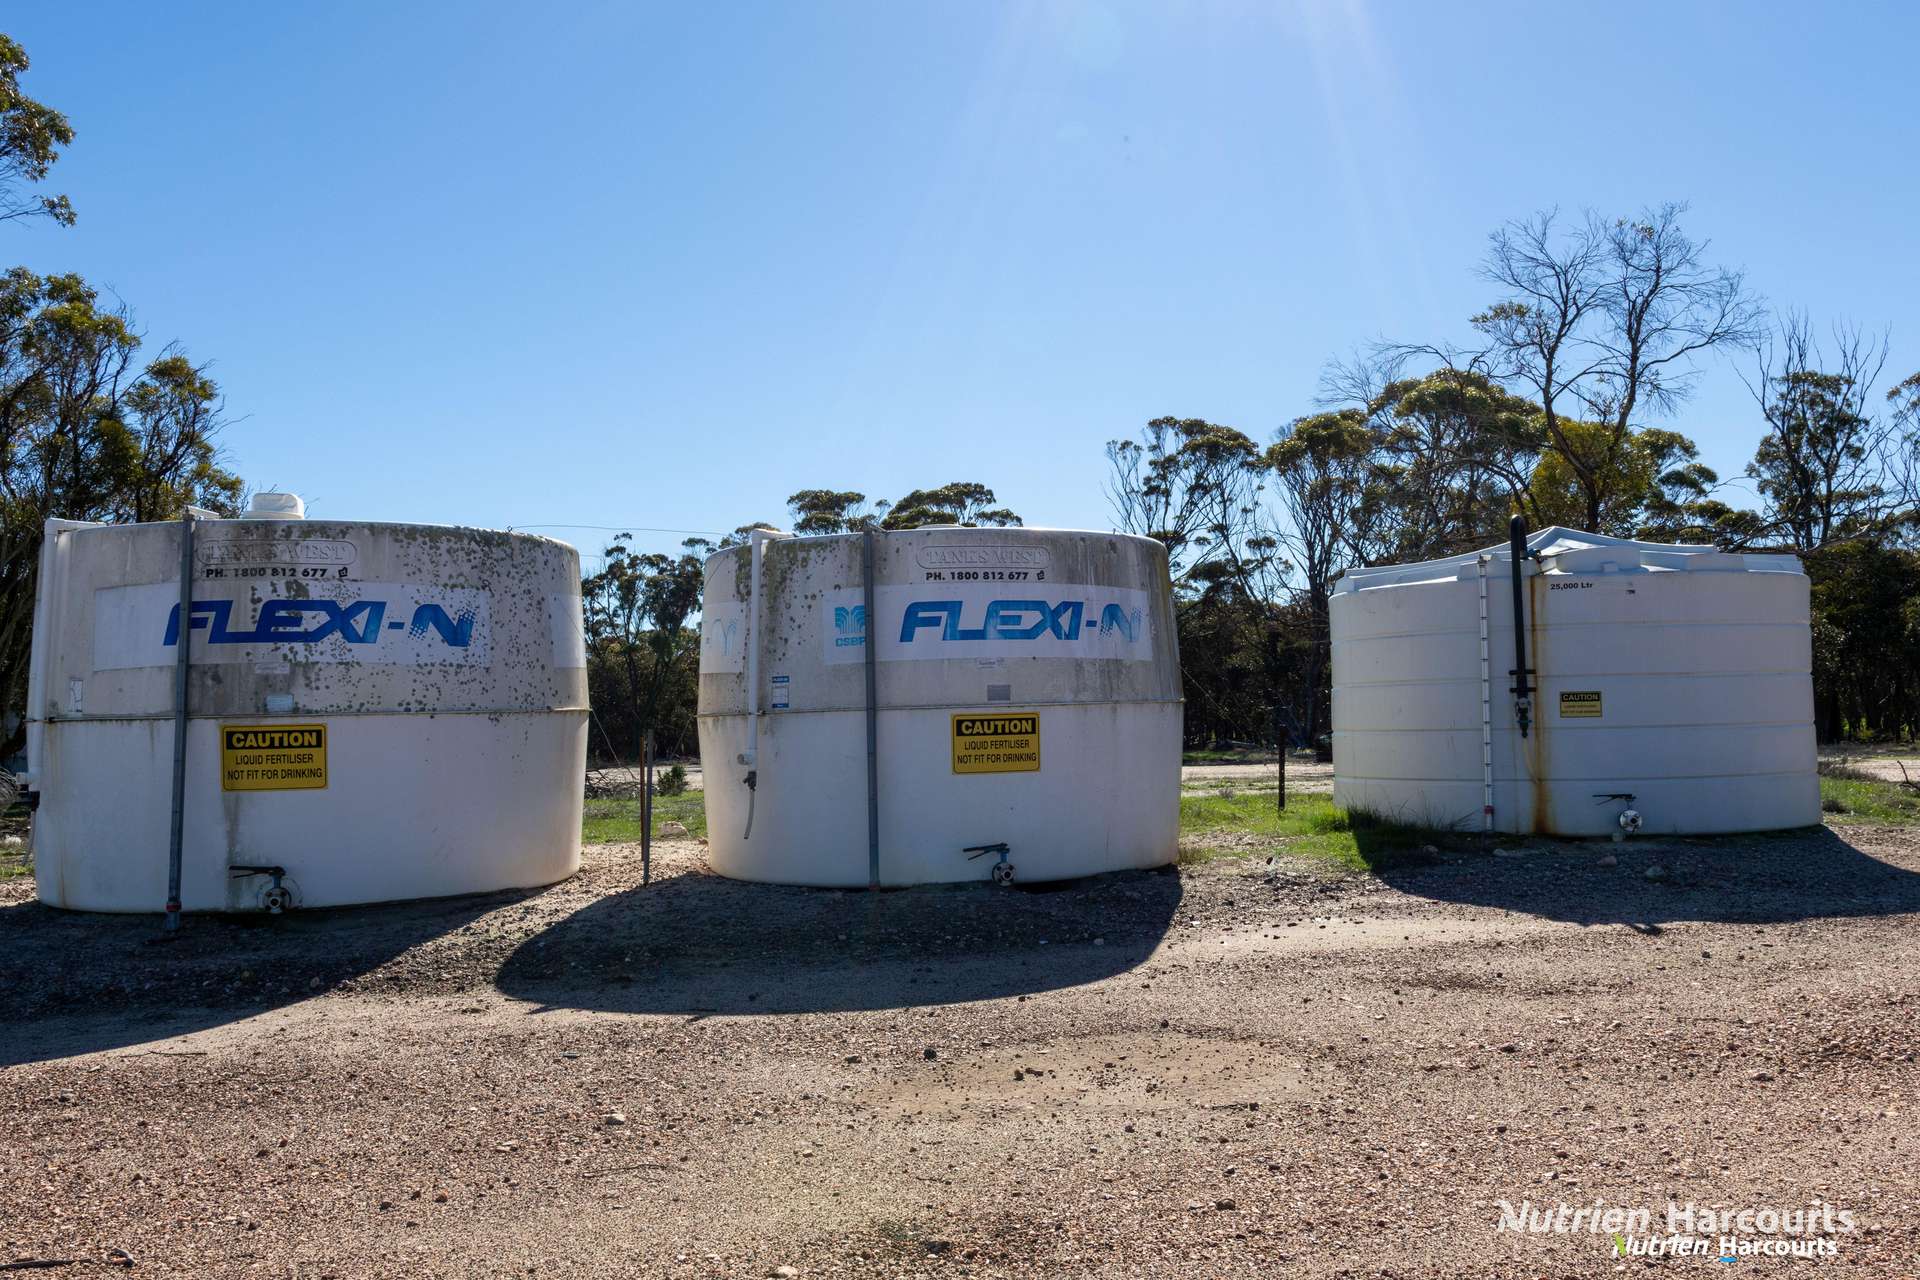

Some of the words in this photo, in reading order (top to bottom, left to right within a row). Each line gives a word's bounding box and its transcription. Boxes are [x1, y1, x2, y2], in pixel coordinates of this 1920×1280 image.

[205, 568, 228, 578] PH.
[234, 568, 267, 577] 1800
[271, 567, 297, 577] 812
[301, 567, 328, 577] 677
[926, 572, 946, 580] PH.
[950, 571, 979, 580] 1800
[983, 571, 1004, 580] 812
[1008, 571, 1029, 580] 677
[1550, 582, 1579, 591] 25,000
[163, 599, 476, 648] FLEXI-N
[899, 599, 1143, 643] FLEXI-N
[1562, 693, 1599, 701] CAUTION
[961, 719, 1033, 734] CAUTION
[231, 732, 317, 747] CAUTION
[964, 740, 989, 751] LIQUID
[990, 739, 1030, 750] FERTILISER
[235, 754, 263, 765] LIQUID
[265, 753, 314, 765] FERTILISER
[957, 754, 972, 765] NOT
[974, 754, 985, 764] FIT
[987, 753, 1001, 763] FOR
[1003, 752, 1037, 762] DRINKING
[227, 769, 244, 781] NOT
[247, 769, 259, 780] FIT
[261, 769, 279, 780] FOR
[281, 767, 323, 779] DRINKING
